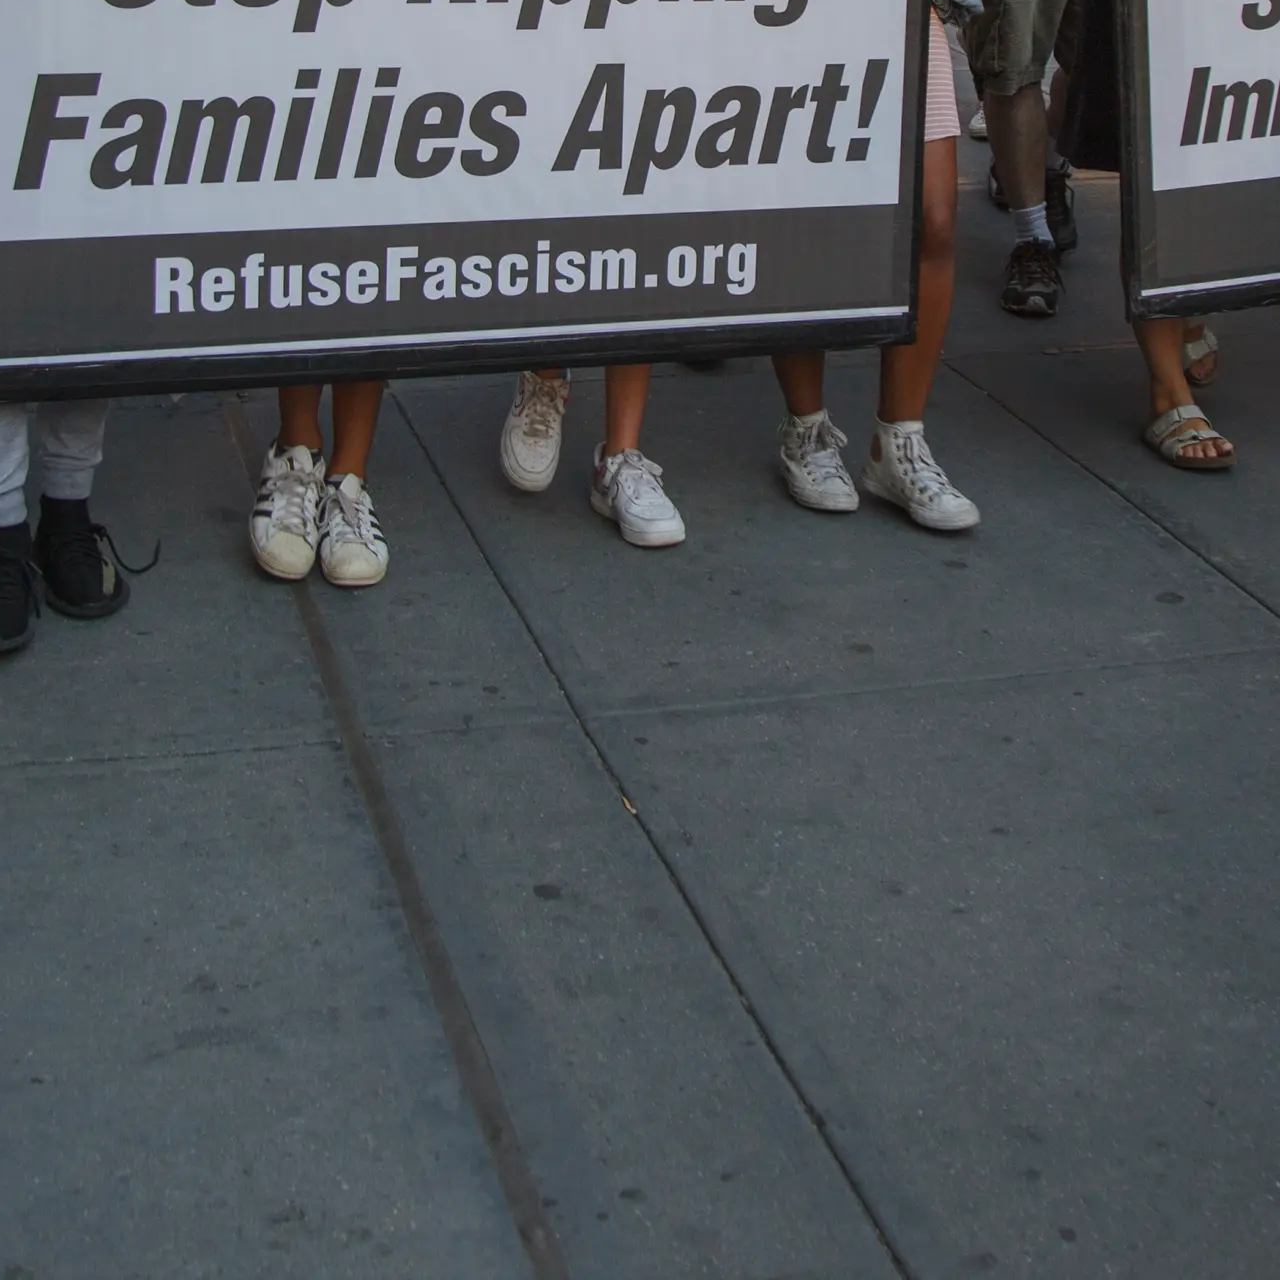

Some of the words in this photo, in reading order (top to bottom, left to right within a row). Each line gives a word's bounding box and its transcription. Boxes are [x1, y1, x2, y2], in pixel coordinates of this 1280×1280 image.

[13, 67, 527, 193] Families
[551, 58, 890, 197] Apart!
[154, 239, 758, 316] RefuseFascism.org
